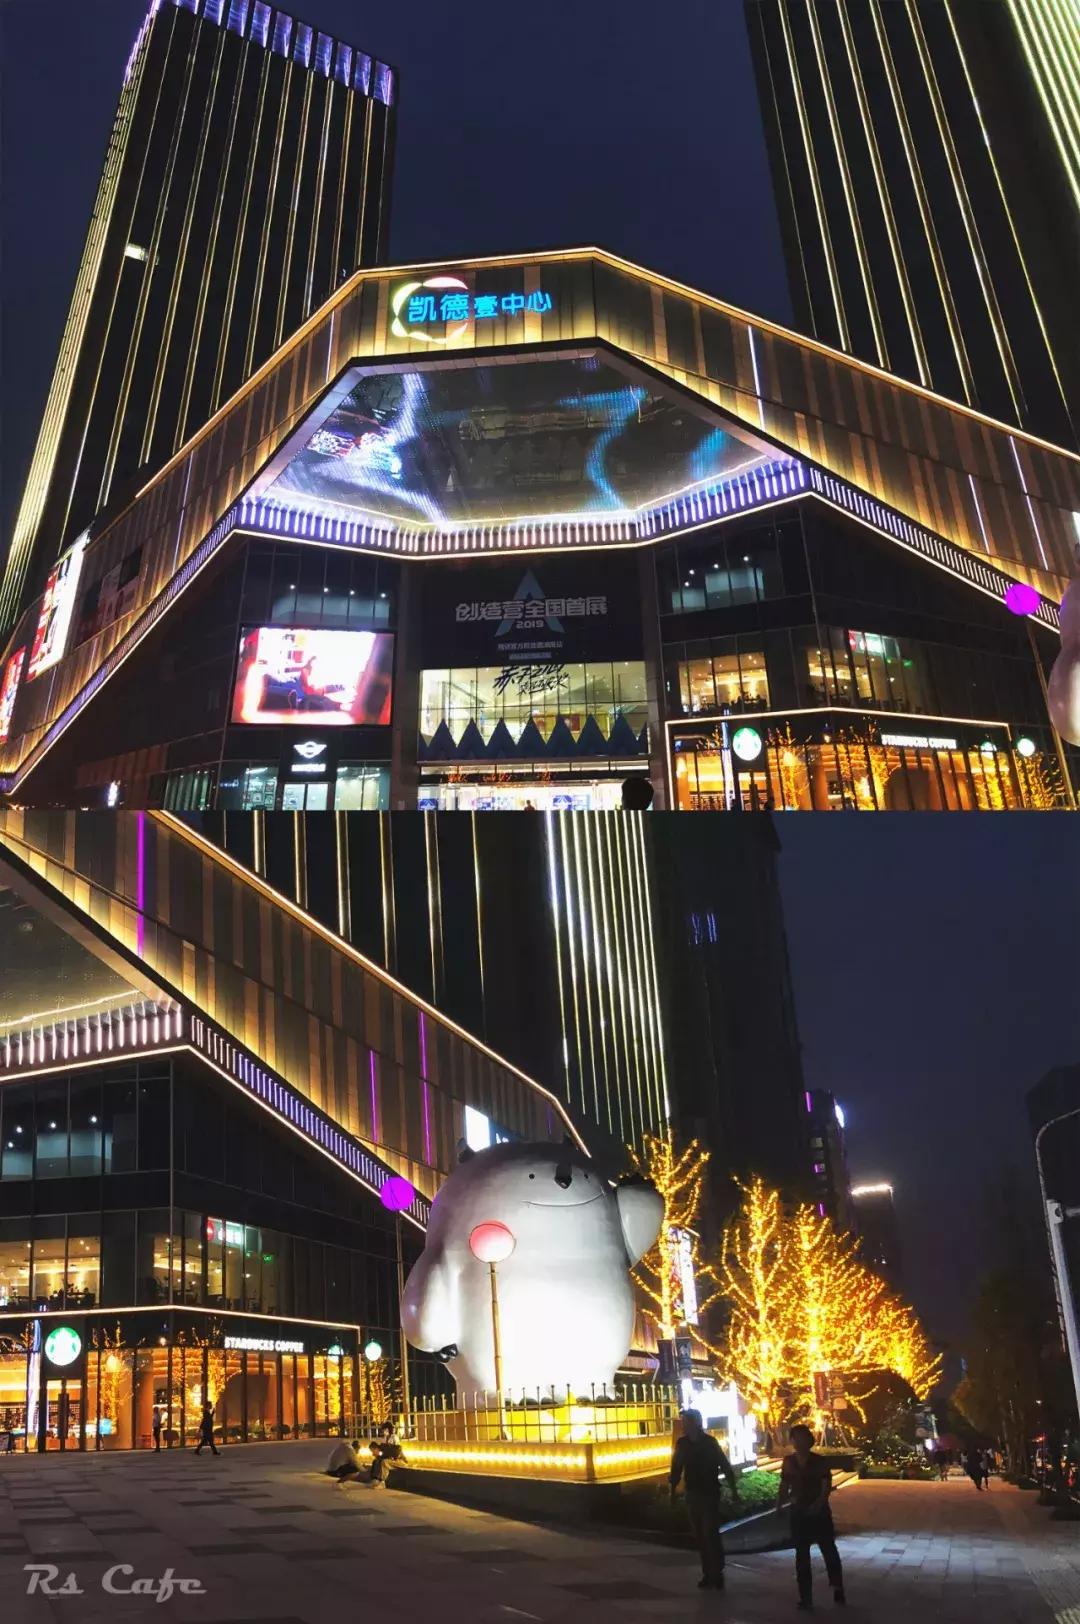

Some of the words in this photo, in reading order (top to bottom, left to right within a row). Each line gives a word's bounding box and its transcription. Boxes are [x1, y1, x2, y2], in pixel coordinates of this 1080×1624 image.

[455, 596, 608, 621] 创造营全国首展
[515, 620, 545, 629] 2019
[224, 1336, 274, 1351] STARBUCKS
[275, 1341, 304, 1353] COFFEE
